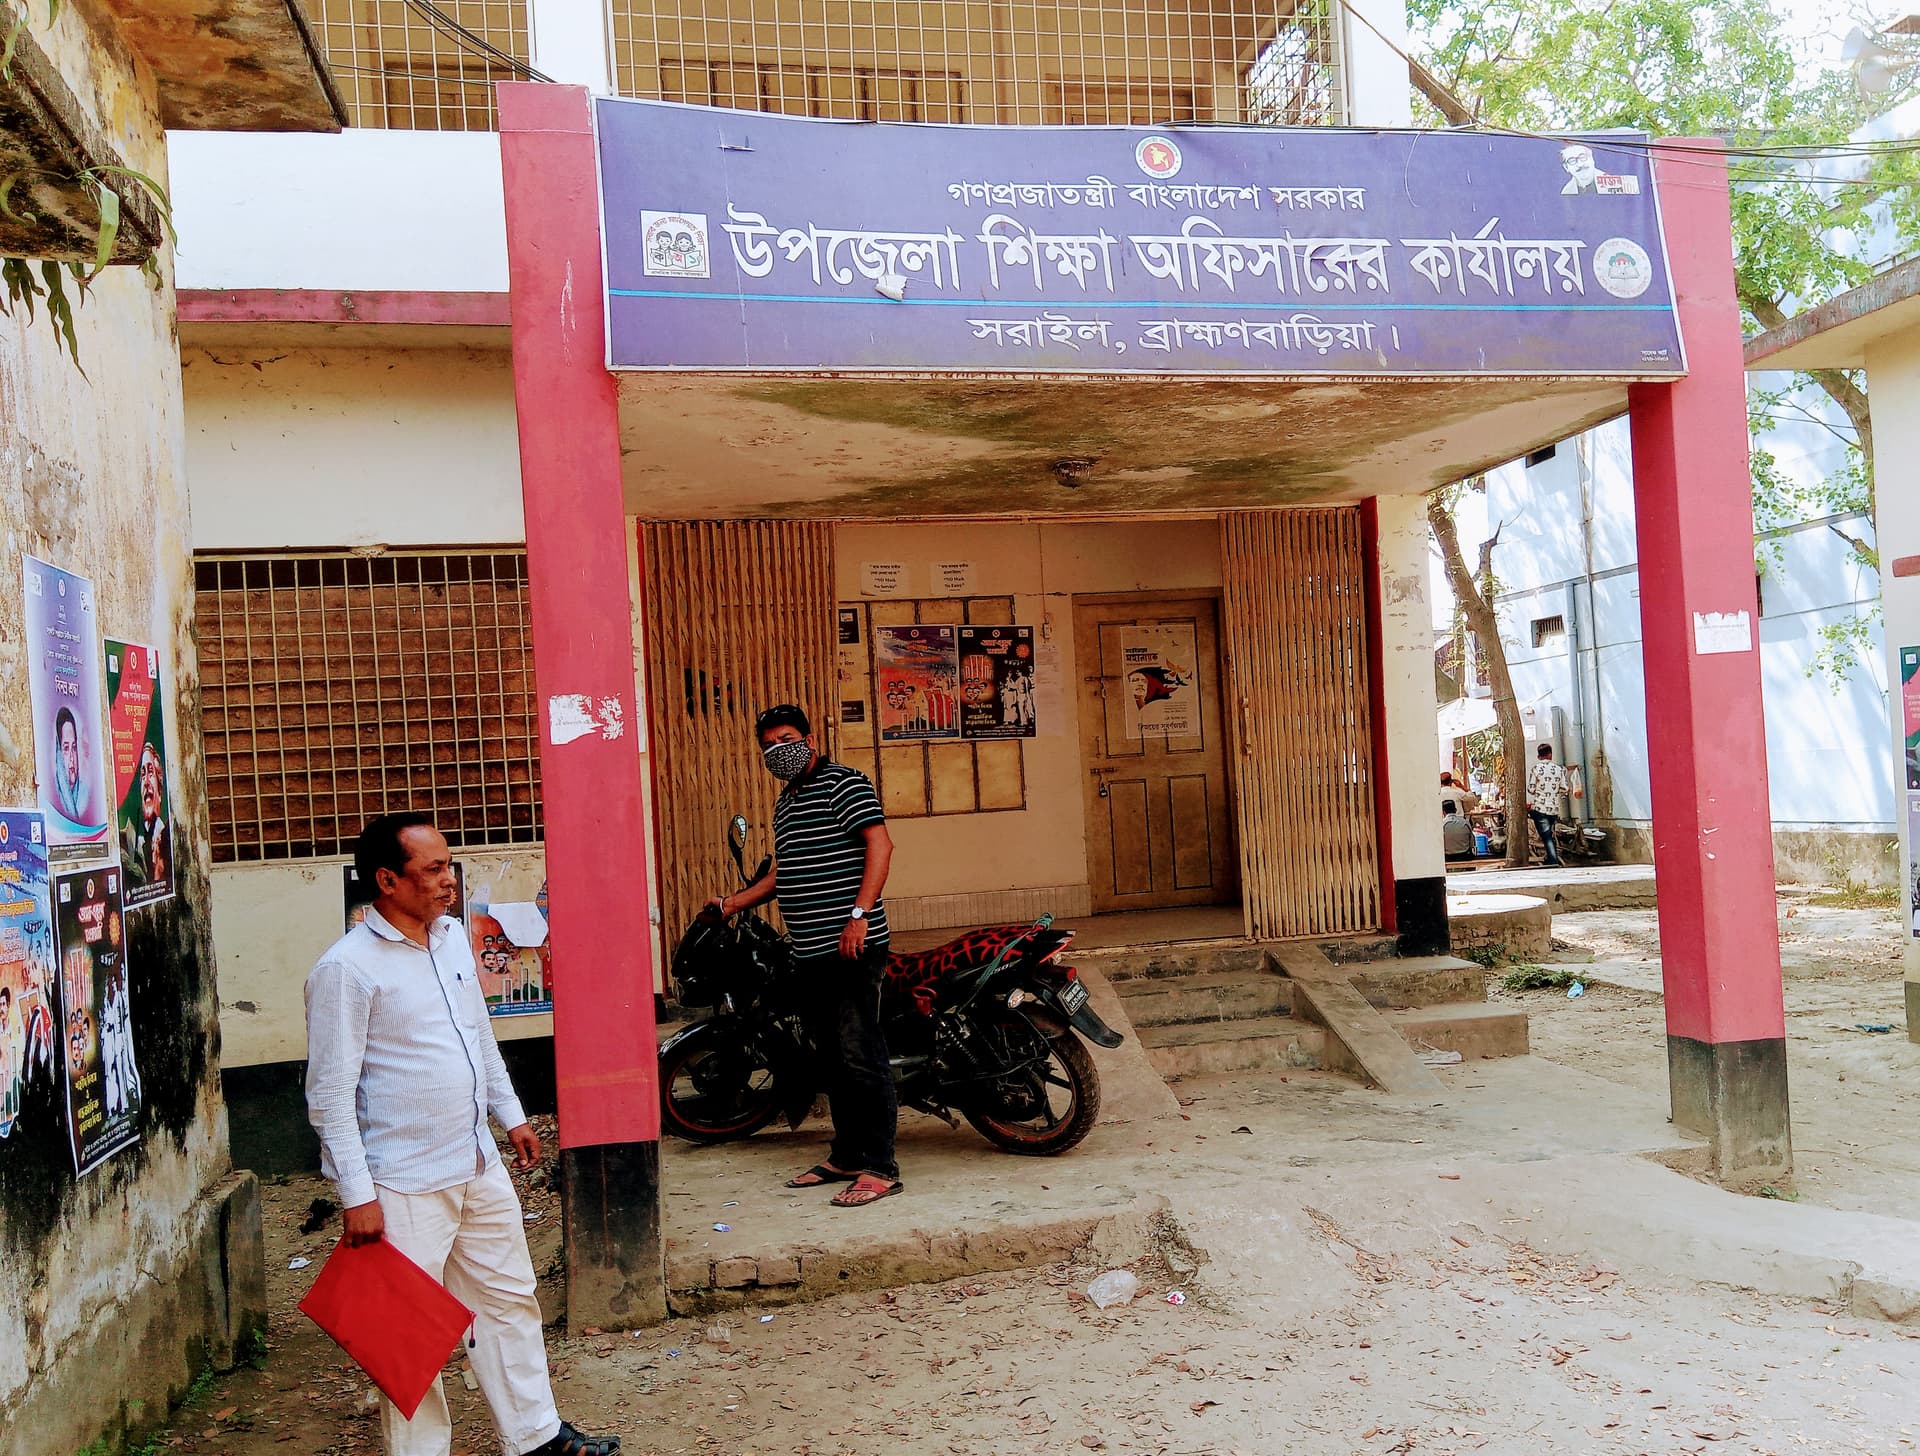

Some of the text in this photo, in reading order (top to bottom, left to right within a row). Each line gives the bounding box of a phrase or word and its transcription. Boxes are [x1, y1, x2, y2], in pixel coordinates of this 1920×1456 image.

[947, 175, 1366, 211] গণপ্রজাতন্ত্রী বাংলাদেশ সরকার
[721, 202, 966, 293] উপজেলা
[976, 214, 1119, 293] শিক্ষা
[1128, 215, 1392, 296] অফিসারের
[1399, 217, 1588, 297] কার্যালয়
[967, 311, 1127, 354] সরাইল,
[1138, 313, 1376, 355] ব্রাহ্মণবাড়িয়া
